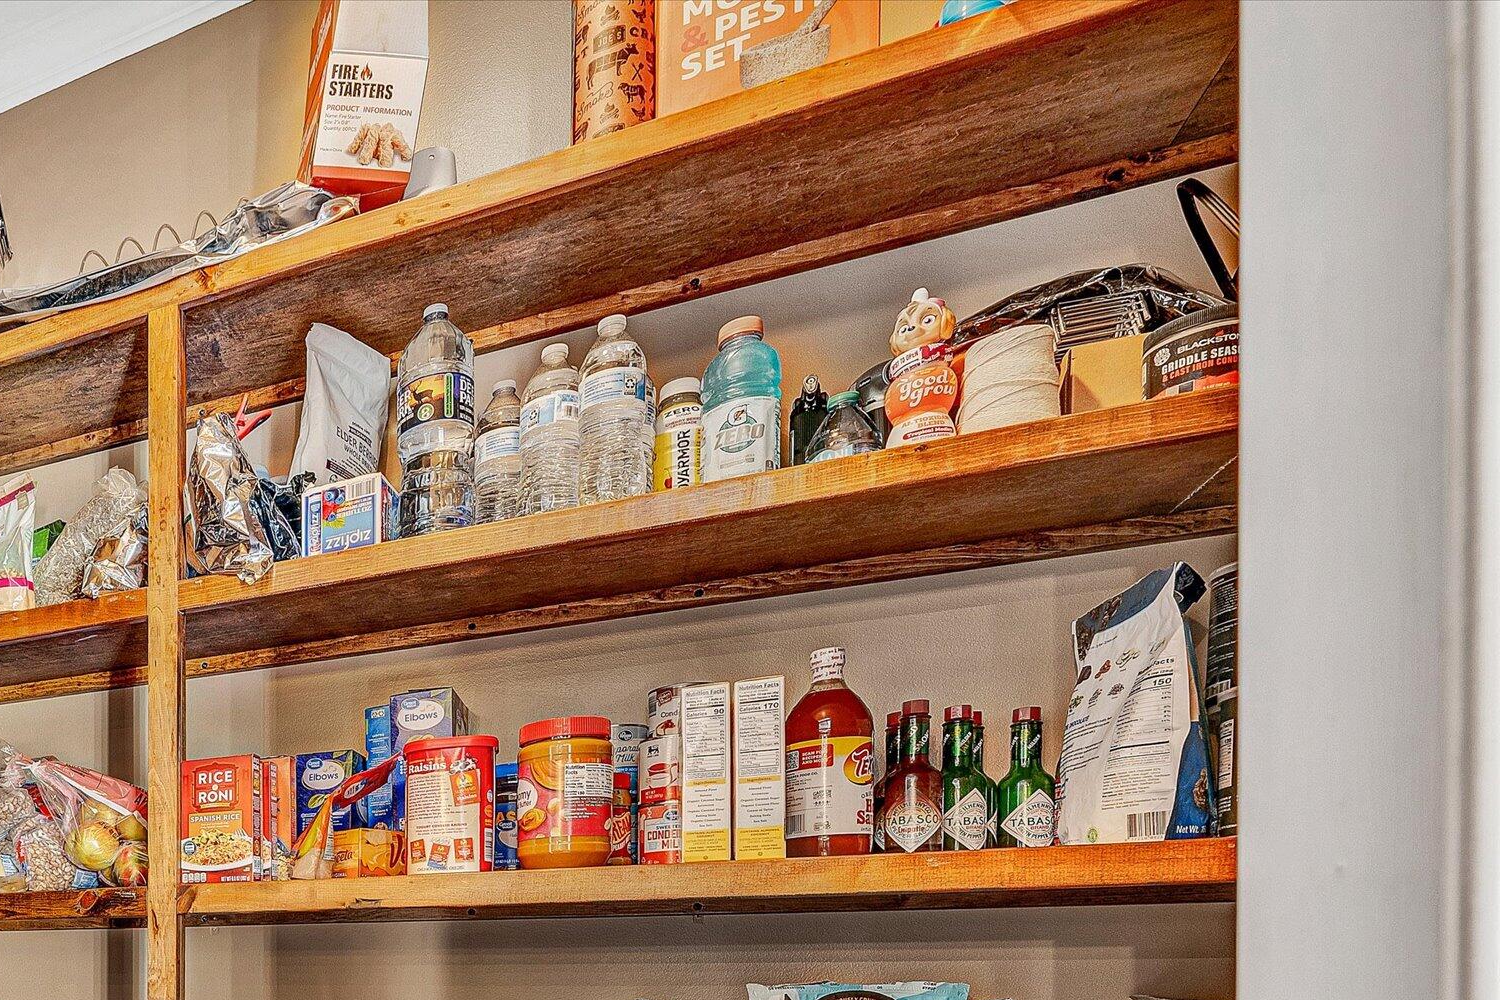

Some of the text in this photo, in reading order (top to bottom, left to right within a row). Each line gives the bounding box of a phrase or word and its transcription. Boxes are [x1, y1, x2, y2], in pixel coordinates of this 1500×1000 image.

[681, 25, 709, 52] &
[681, 35, 750, 81] SET
[331, 63, 359, 80] FIRE
[329, 81, 393, 100] STARTERS
[326, 104, 412, 117] PRODUCT INFORMATION
[1161, 351, 1208, 375] GRIDDLE
[1169, 366, 1190, 379] CAST
[1192, 360, 1214, 372] IRON
[1216, 356, 1239, 366] COND
[900, 369, 948, 401] good
[910, 384, 954, 408] grow
[664, 405, 700, 419] ZERO
[336, 426, 358, 450] ELDER
[714, 424, 765, 450] ZERO
[325, 528, 372, 550] zipfizz
[1152, 678, 1172, 686] 150
[404, 709, 438, 724] Elbows
[660, 710, 679, 718] Cond
[616, 755, 636, 763] Milk
[408, 761, 446, 775] Raisins
[198, 770, 233, 784] RICE
[308, 772, 339, 782] Elbows
[198, 789, 233, 803] RONI
[190, 815, 221, 823] SPANISH
[887, 814, 938, 828] TABASCO
[1176, 824, 1188, 833] Net
[662, 840, 680, 850] MIL
